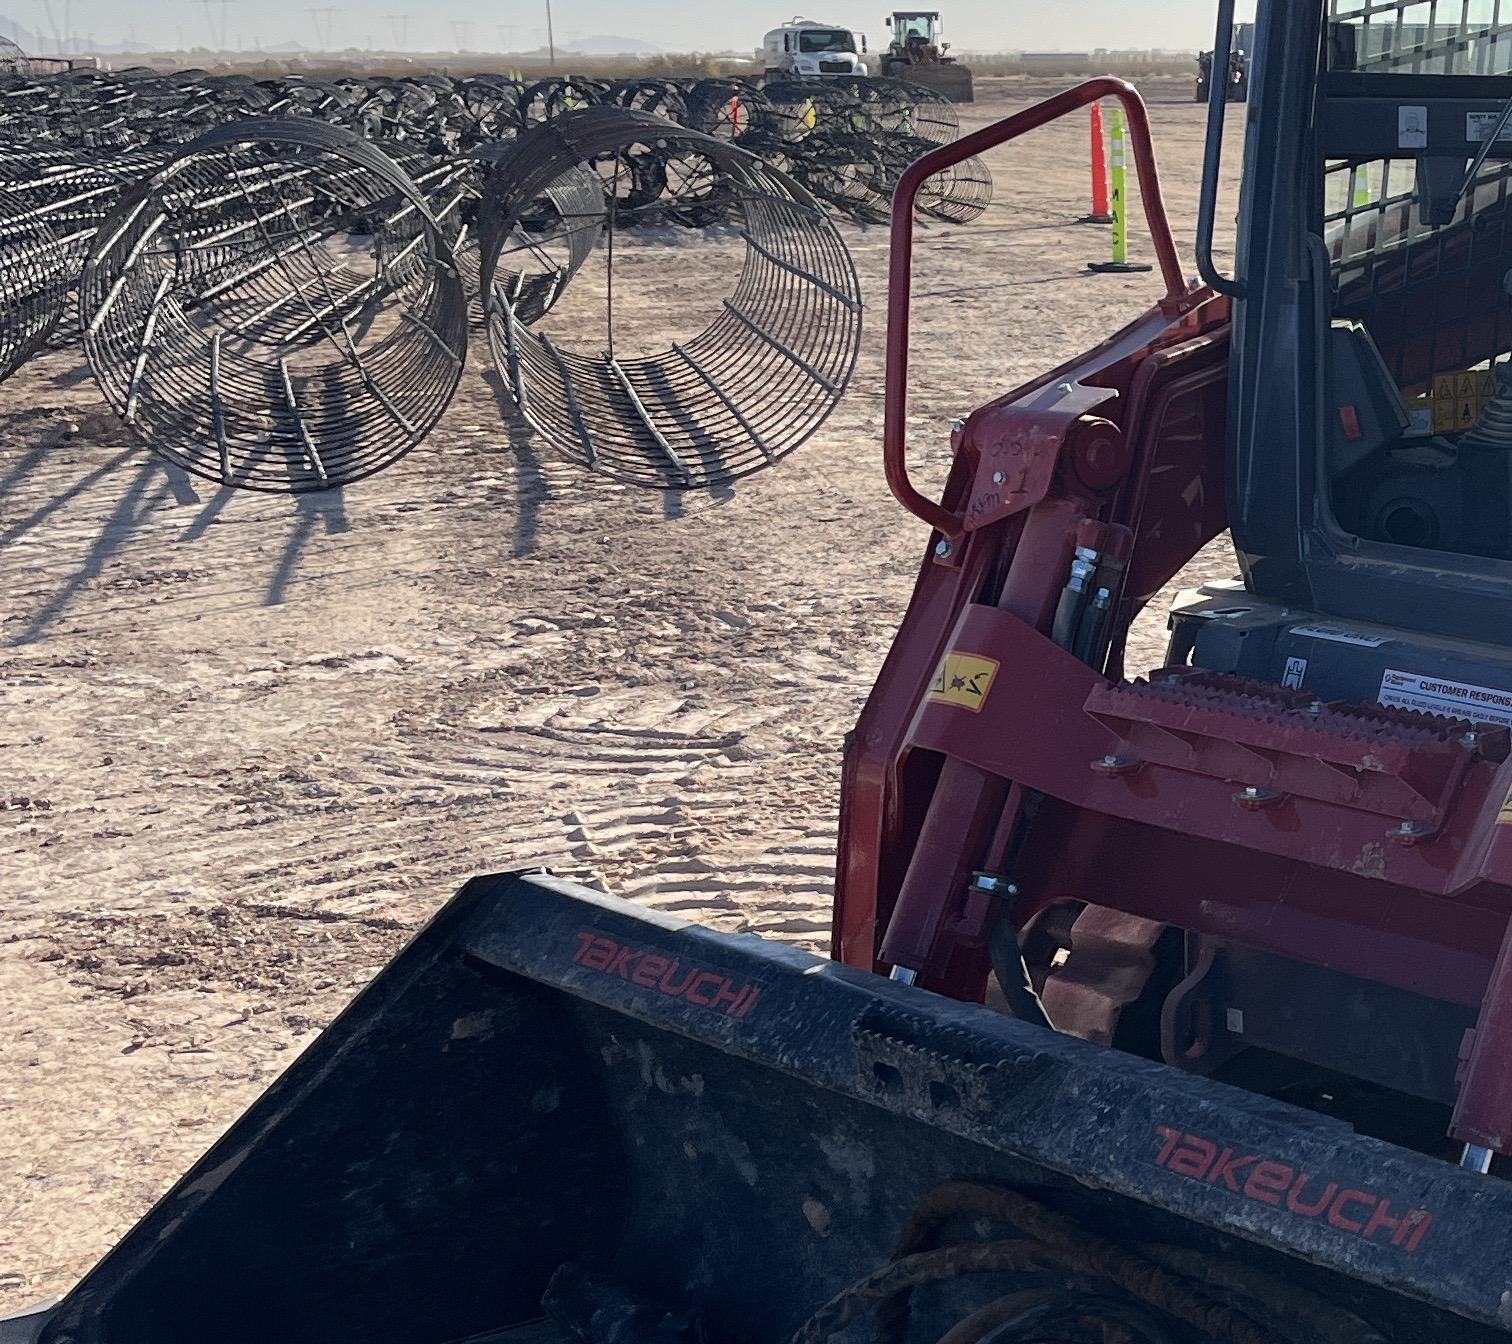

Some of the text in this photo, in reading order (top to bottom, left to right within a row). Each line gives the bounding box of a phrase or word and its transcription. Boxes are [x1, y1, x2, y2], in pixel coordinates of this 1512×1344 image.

[1419, 680, 1473, 699] CUSTOMER
[572, 931, 762, 1018] TAKEUCHI
[1155, 1124, 1433, 1252] TAKEUCHI
